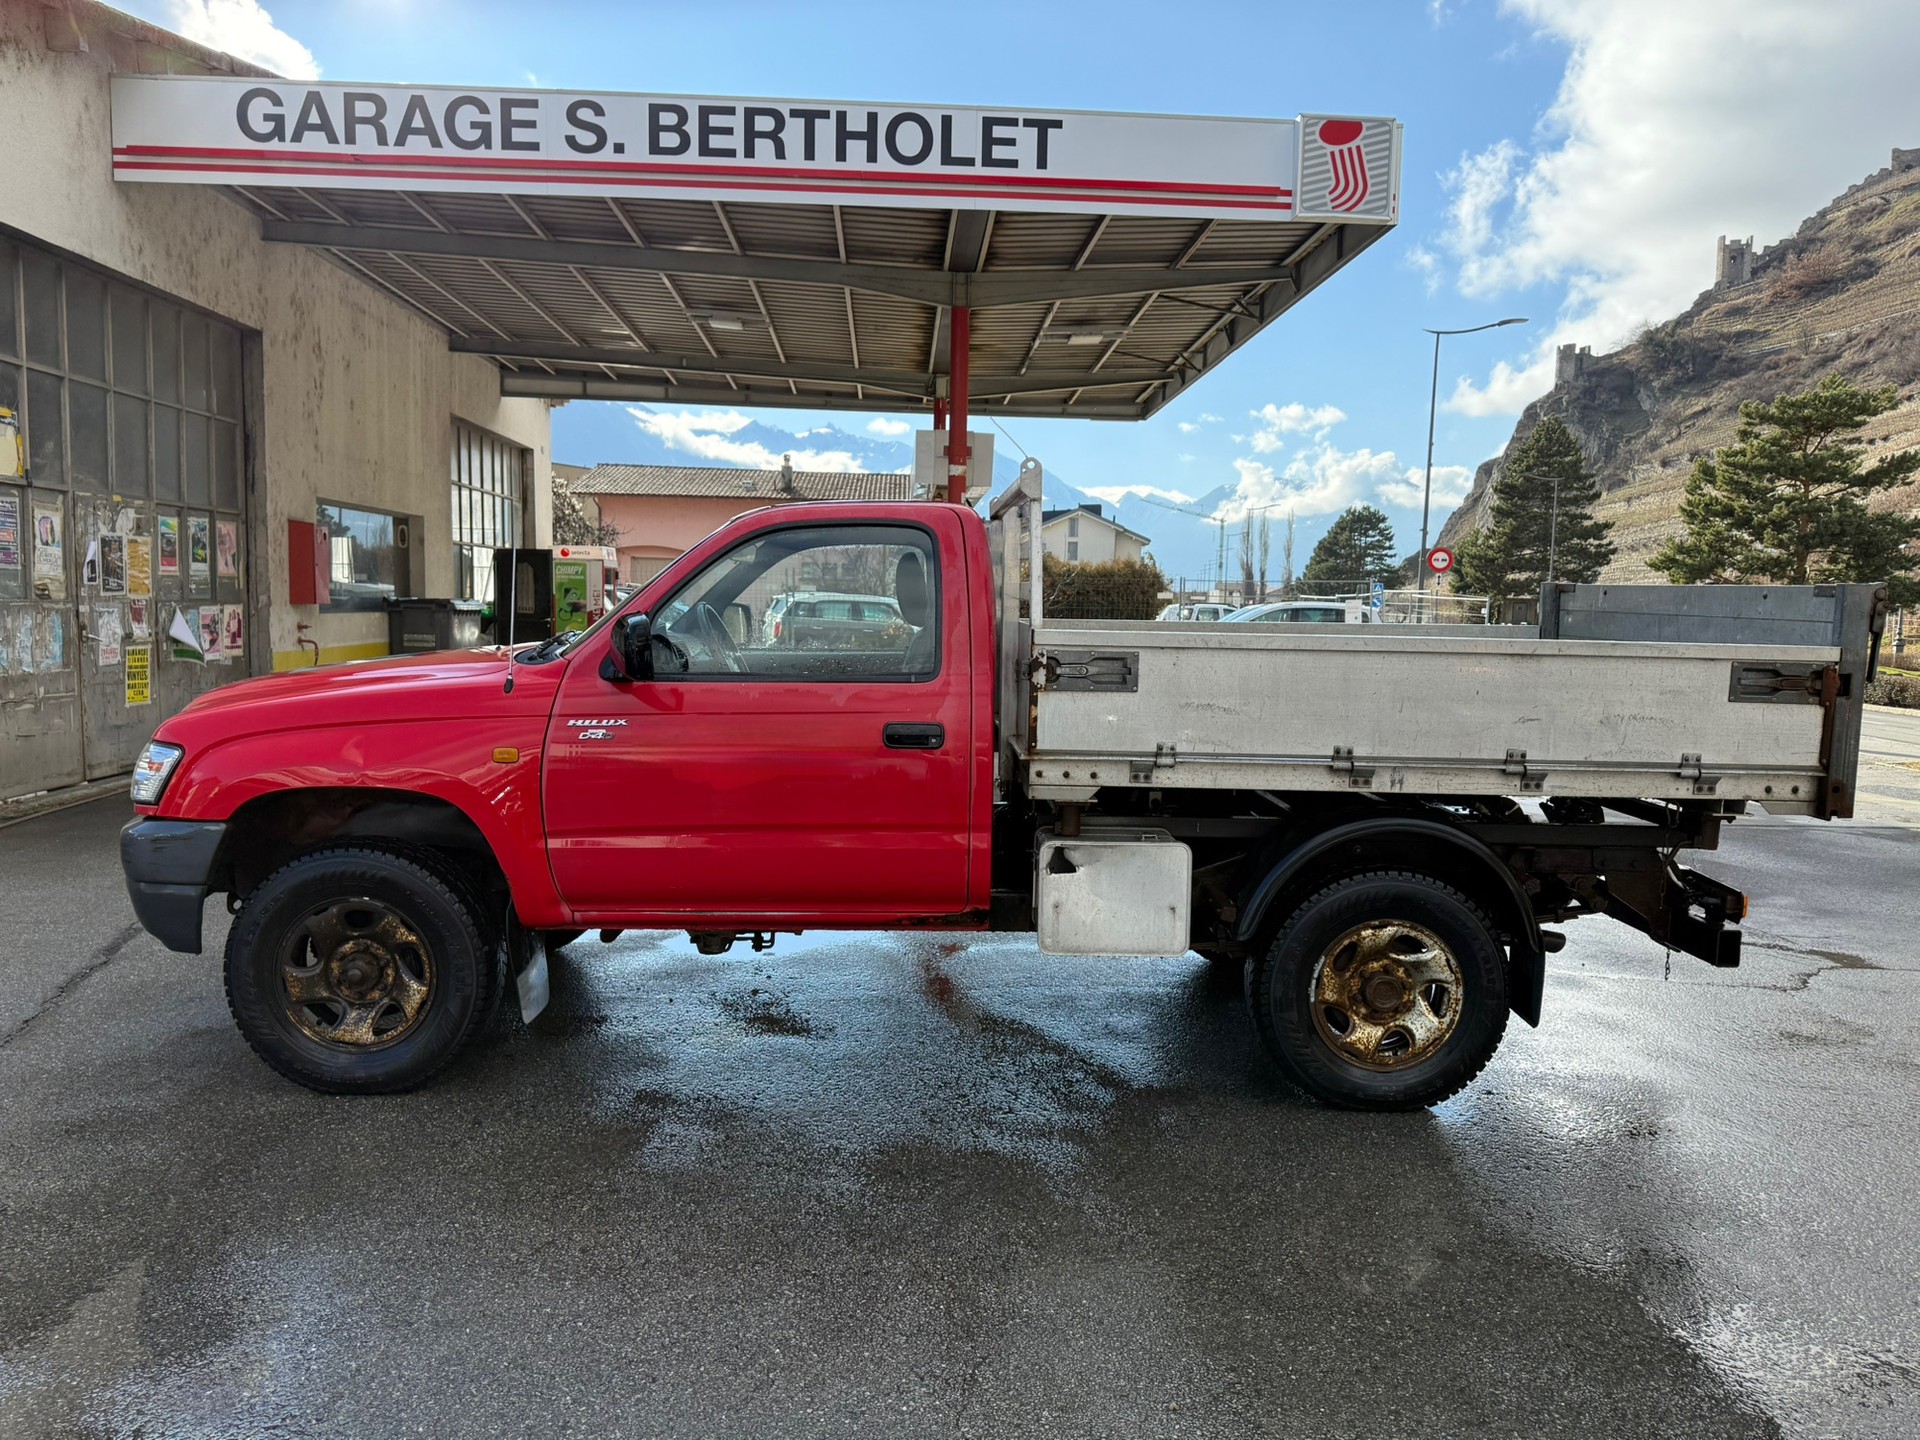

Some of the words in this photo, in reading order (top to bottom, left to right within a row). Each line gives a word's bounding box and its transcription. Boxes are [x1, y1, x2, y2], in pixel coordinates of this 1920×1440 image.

[236, 87, 540, 152] GARAGE
[564, 99, 625, 154] S.
[648, 102, 1063, 170] BERTHOLET
[555, 565, 583, 575] CHIMPY
